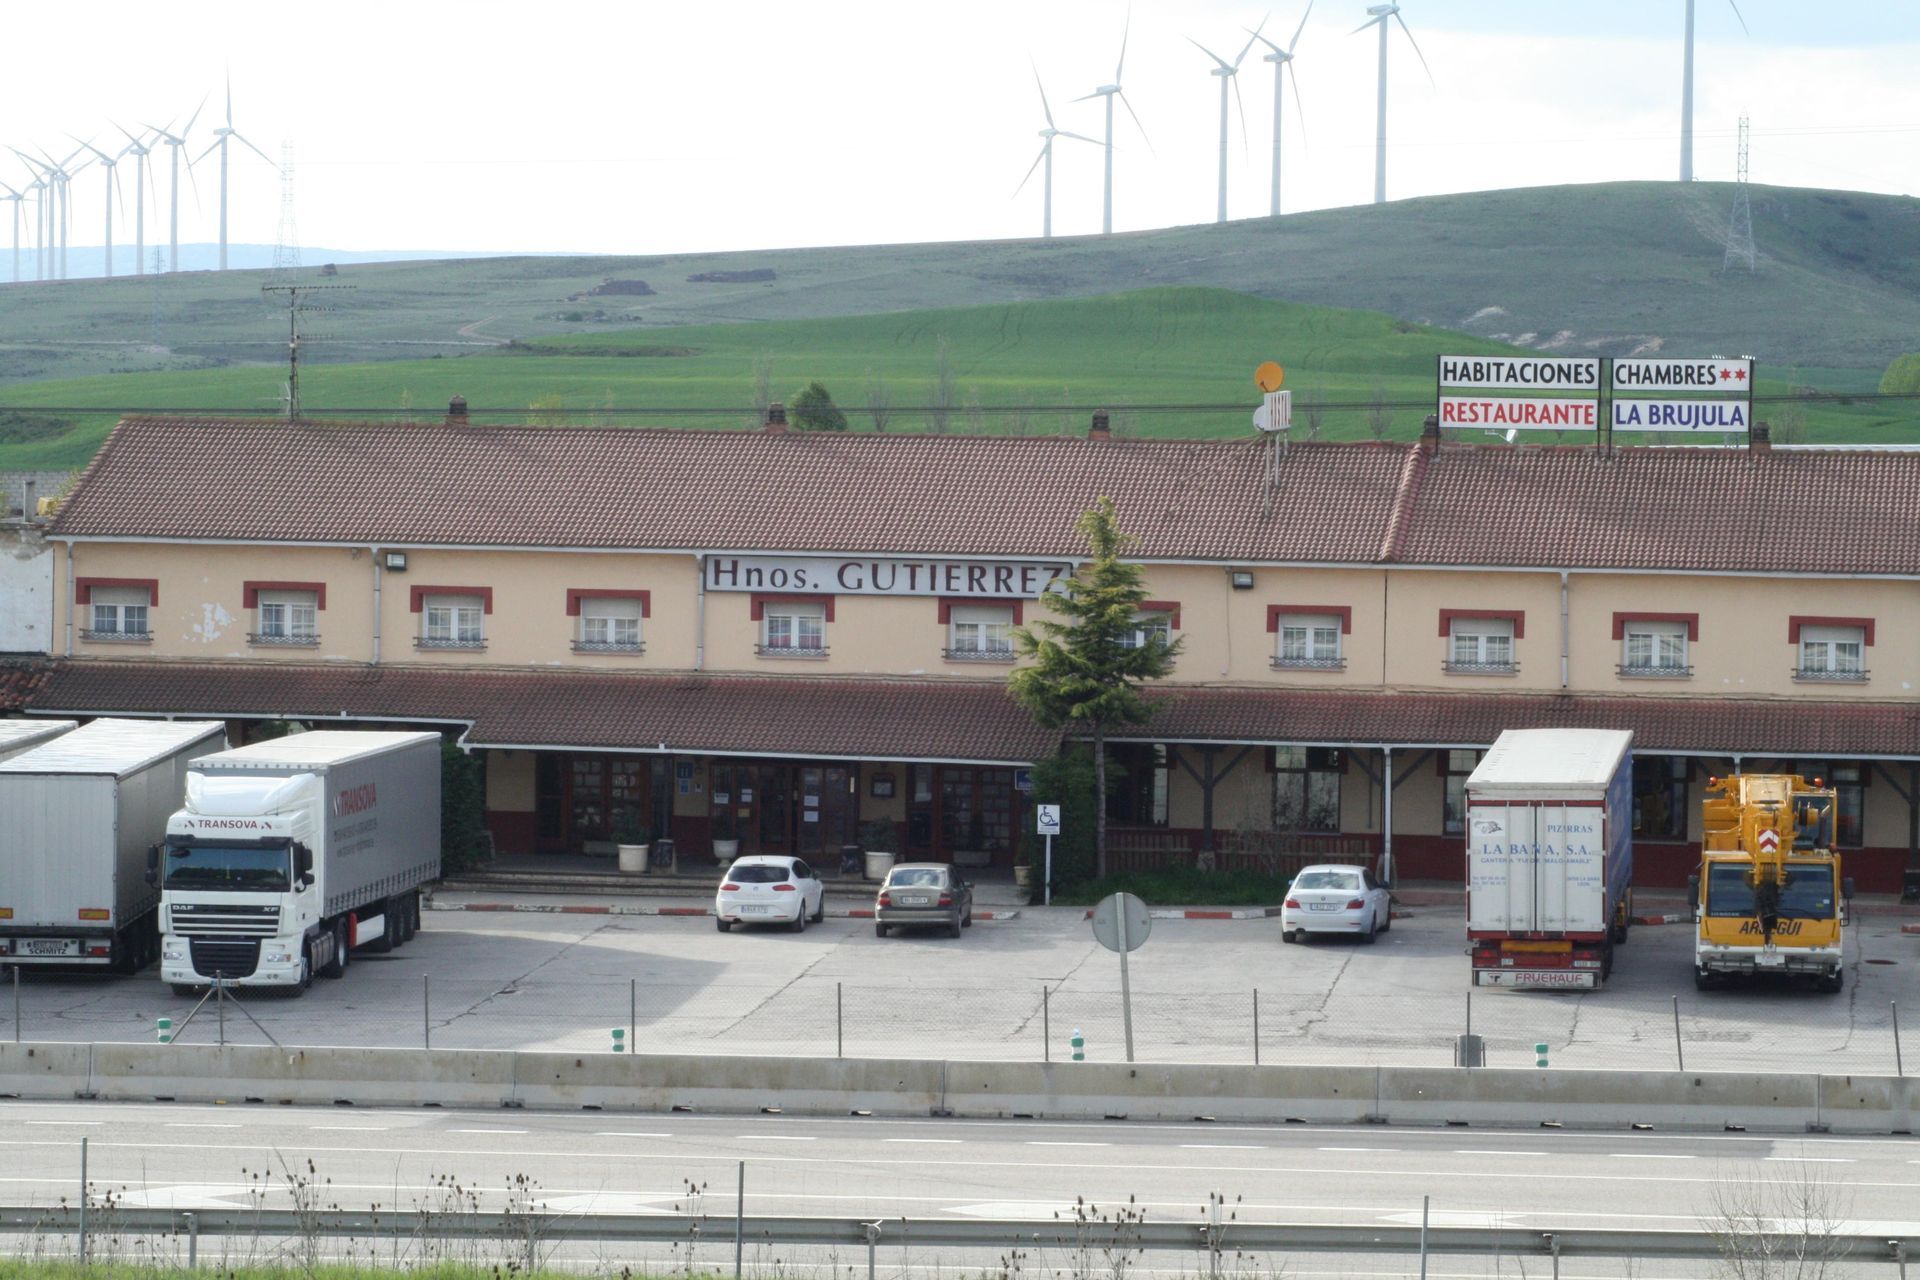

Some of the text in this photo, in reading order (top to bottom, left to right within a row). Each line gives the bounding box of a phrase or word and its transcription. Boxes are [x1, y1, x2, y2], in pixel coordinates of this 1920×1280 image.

[1442, 361, 1595, 384] HABITACIONES
[1615, 363, 1716, 386] CHAMBRES
[1442, 401, 1595, 425] RESTAURANTE
[1615, 404, 1745, 430] LA BRUJULA
[713, 559, 1064, 595] Hnos. GUTIERREZ
[198, 819, 258, 829] TRANSOVA
[1483, 844, 1503, 855] LA
[1739, 921, 1802, 935] ARGUI
[1515, 973, 1583, 984] FRUEHAUF
